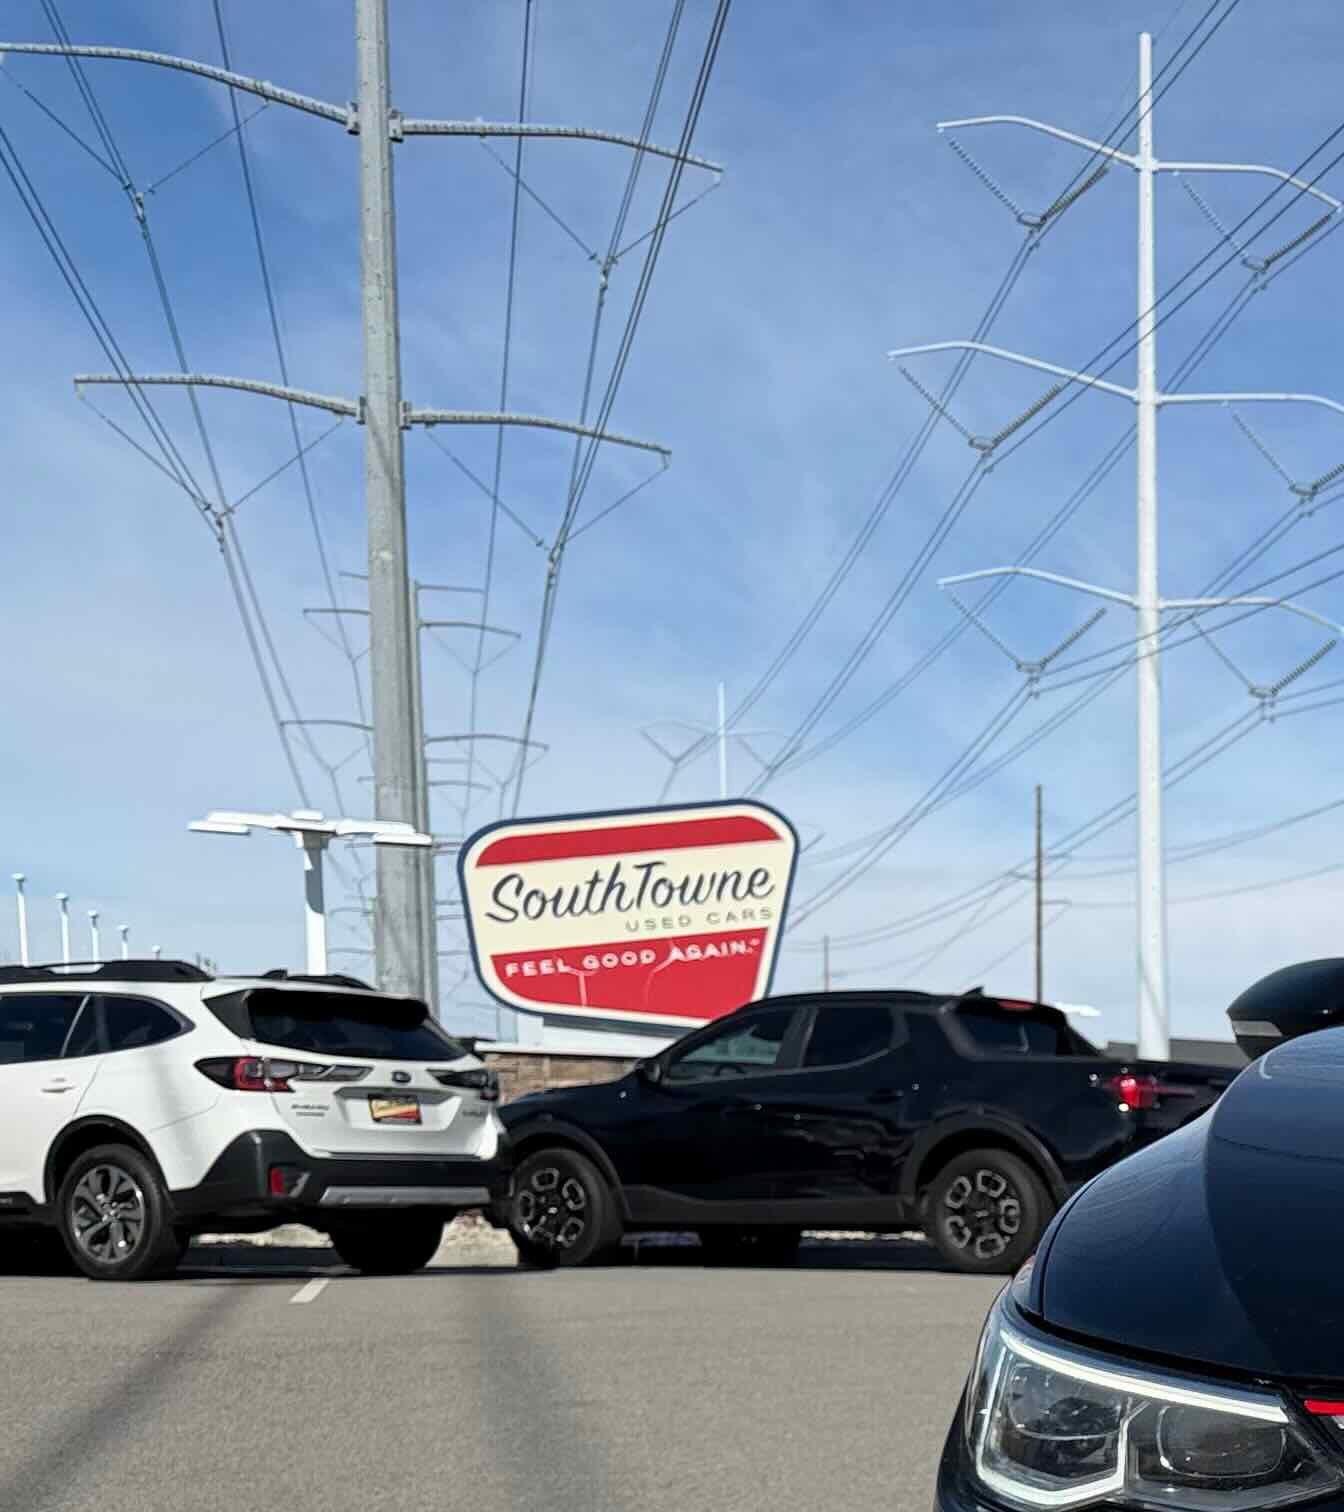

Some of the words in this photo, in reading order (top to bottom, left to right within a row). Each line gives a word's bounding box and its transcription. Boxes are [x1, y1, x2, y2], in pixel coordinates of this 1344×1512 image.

[485, 861, 775, 923] SouthTowne
[625, 915, 692, 932] USED
[706, 908, 772, 925] CARS
[505, 958, 571, 977] FEEL
[582, 949, 656, 970] GOOD
